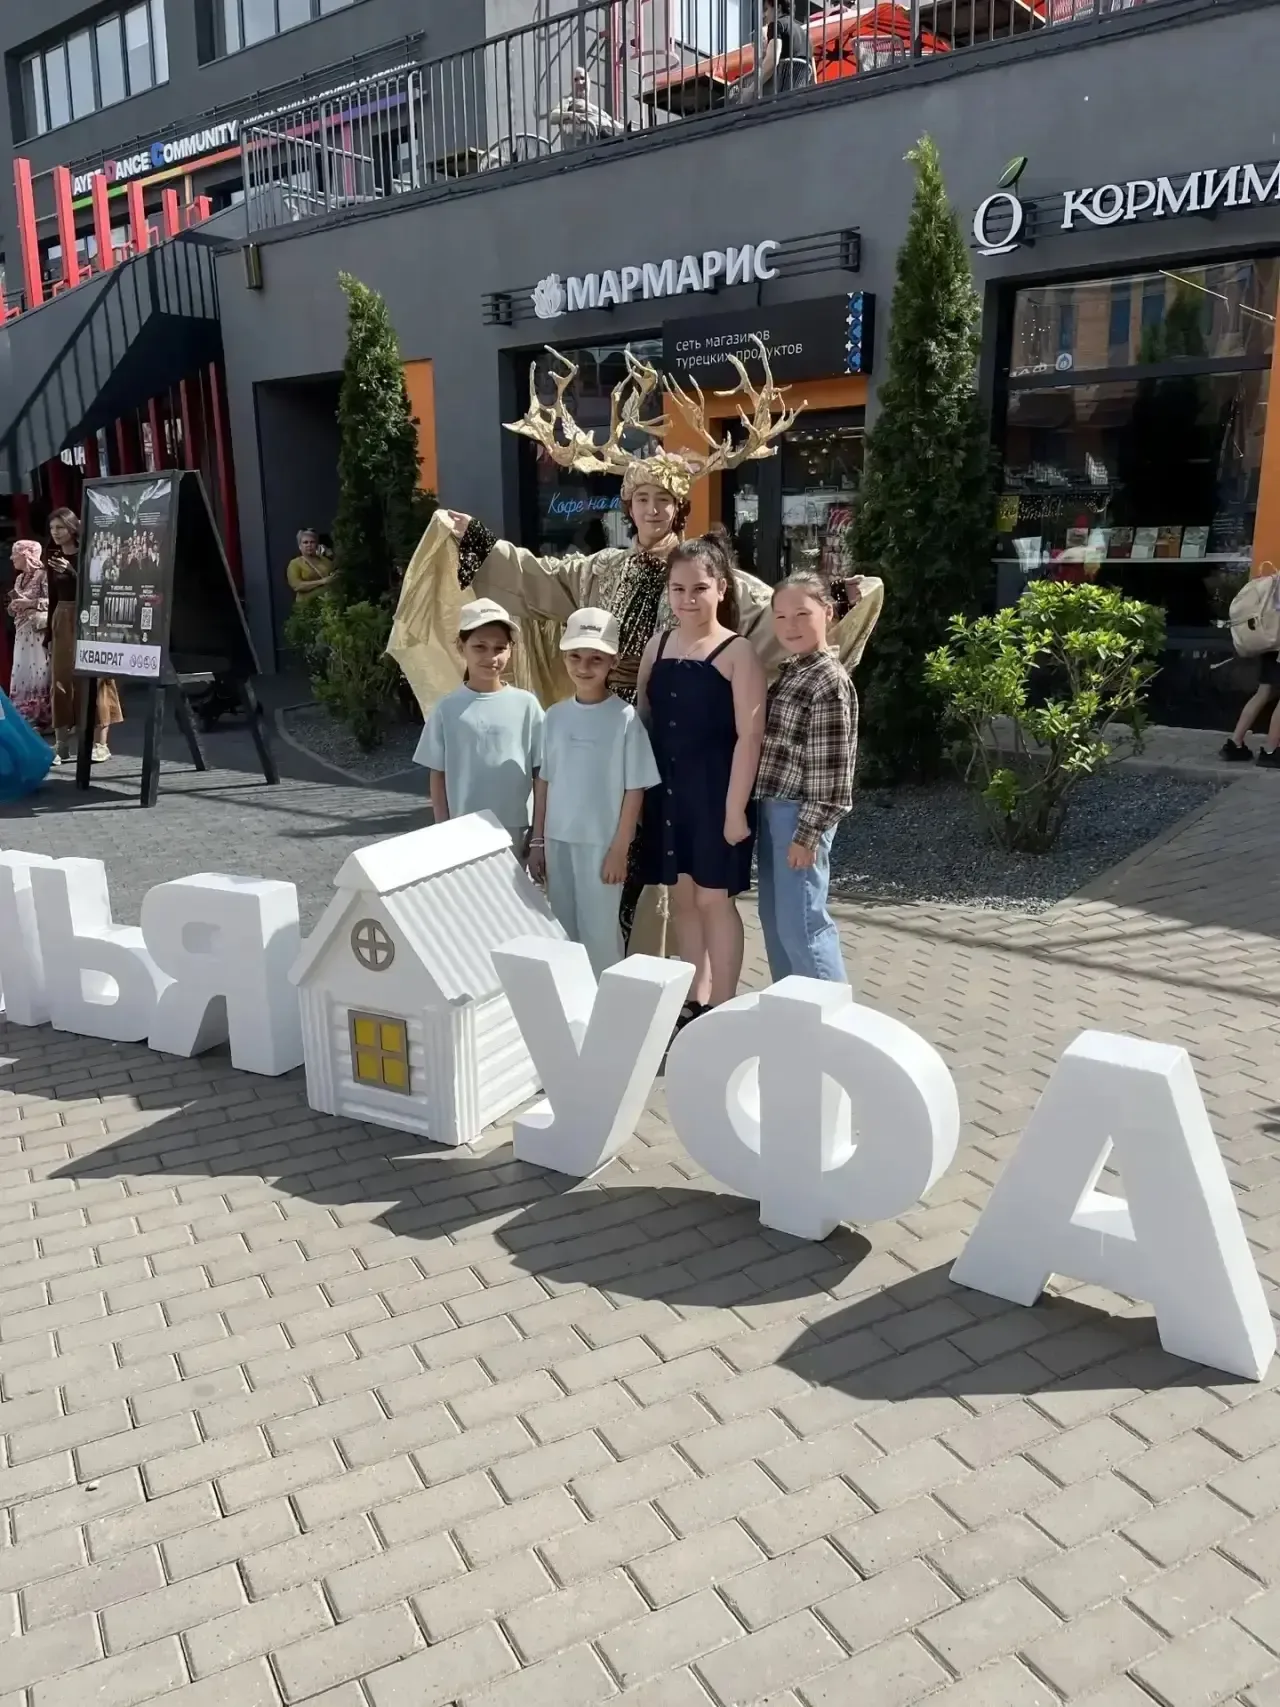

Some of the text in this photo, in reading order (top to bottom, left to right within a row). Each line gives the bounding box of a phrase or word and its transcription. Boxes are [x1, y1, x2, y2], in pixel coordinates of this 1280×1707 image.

[104, 151, 151, 182] DANCE
[150, 120, 239, 168] COMMUNITY
[1061, 161, 1280, 229] КОРМИМ
[566, 240, 780, 312] МАРМАРИС
[675, 339, 701, 352] сеть
[548, 491, 622, 521] Кофе на п
[491, 934, 1278, 1382] УФА
